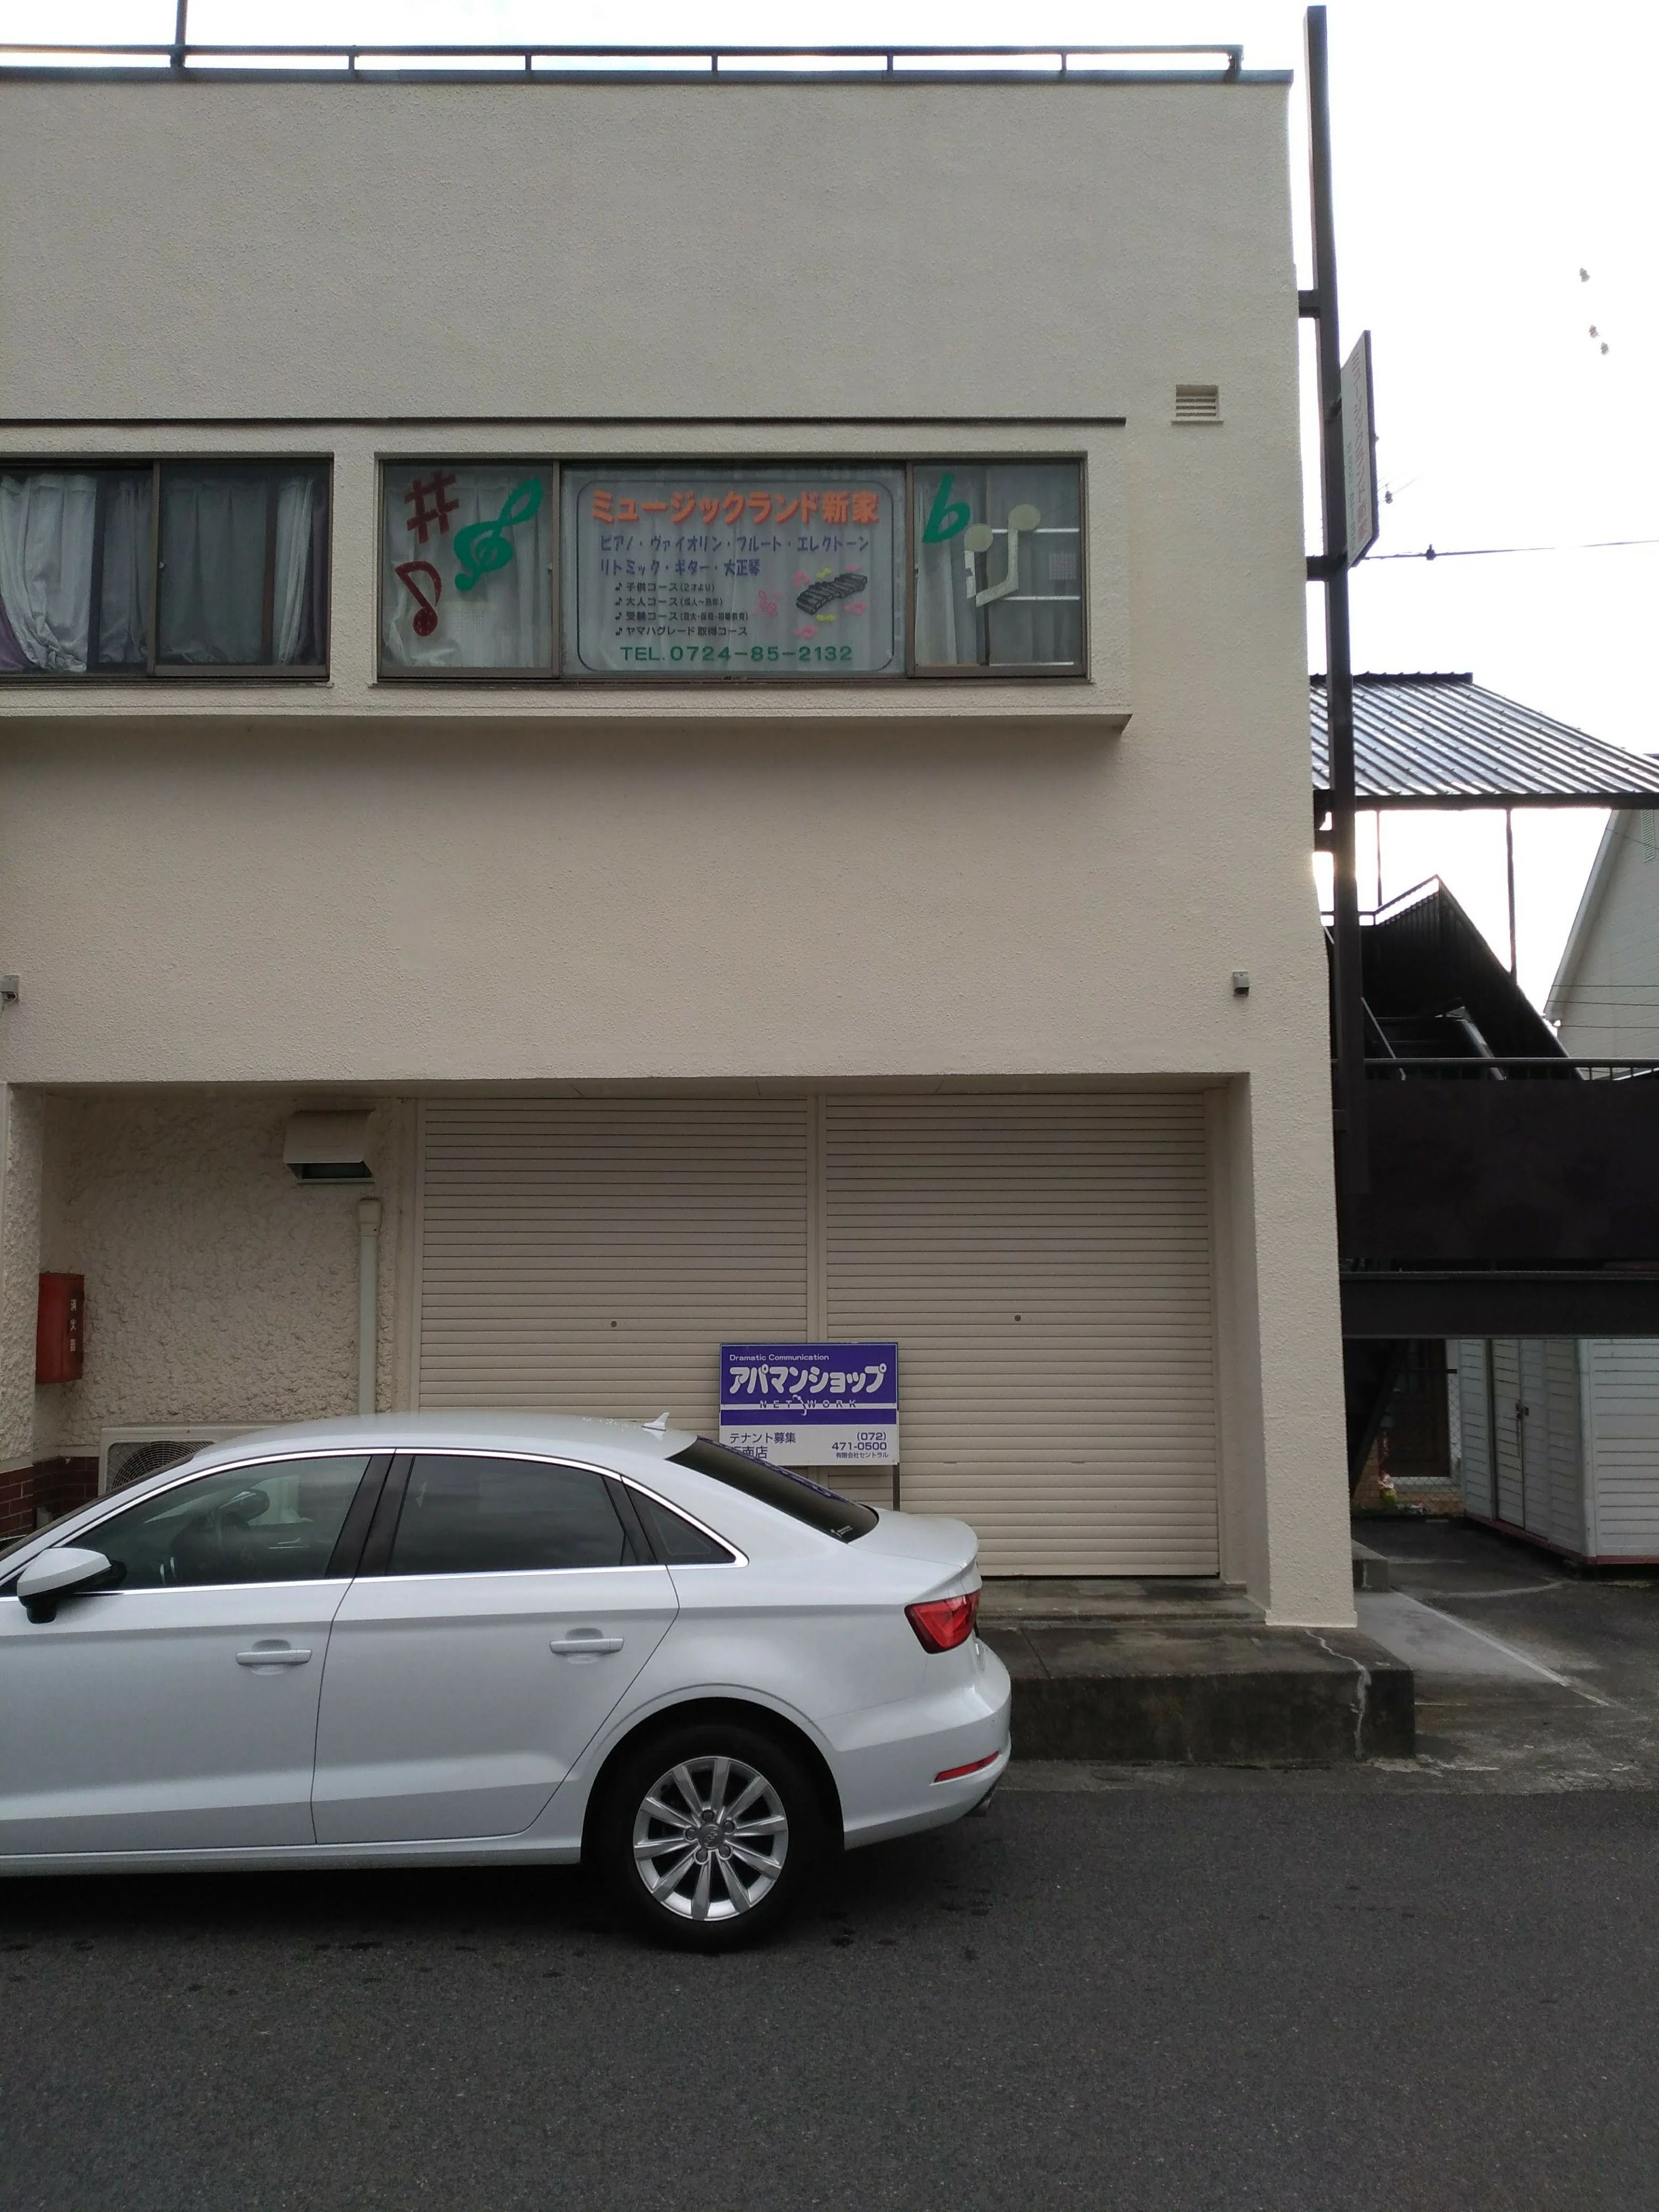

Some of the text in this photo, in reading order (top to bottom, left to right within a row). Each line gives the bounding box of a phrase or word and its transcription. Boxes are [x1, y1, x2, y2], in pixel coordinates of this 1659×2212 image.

[592, 489, 880, 525] ミュージックランド新家
[729, 1363, 888, 1394] アパマンショップ
[729, 1432, 796, 1444] テナント募集
[857, 1431, 886, 1441] (072)
[731, 1445, 768, 1459] 南店
[831, 1442, 887, 1451] 471-0500
